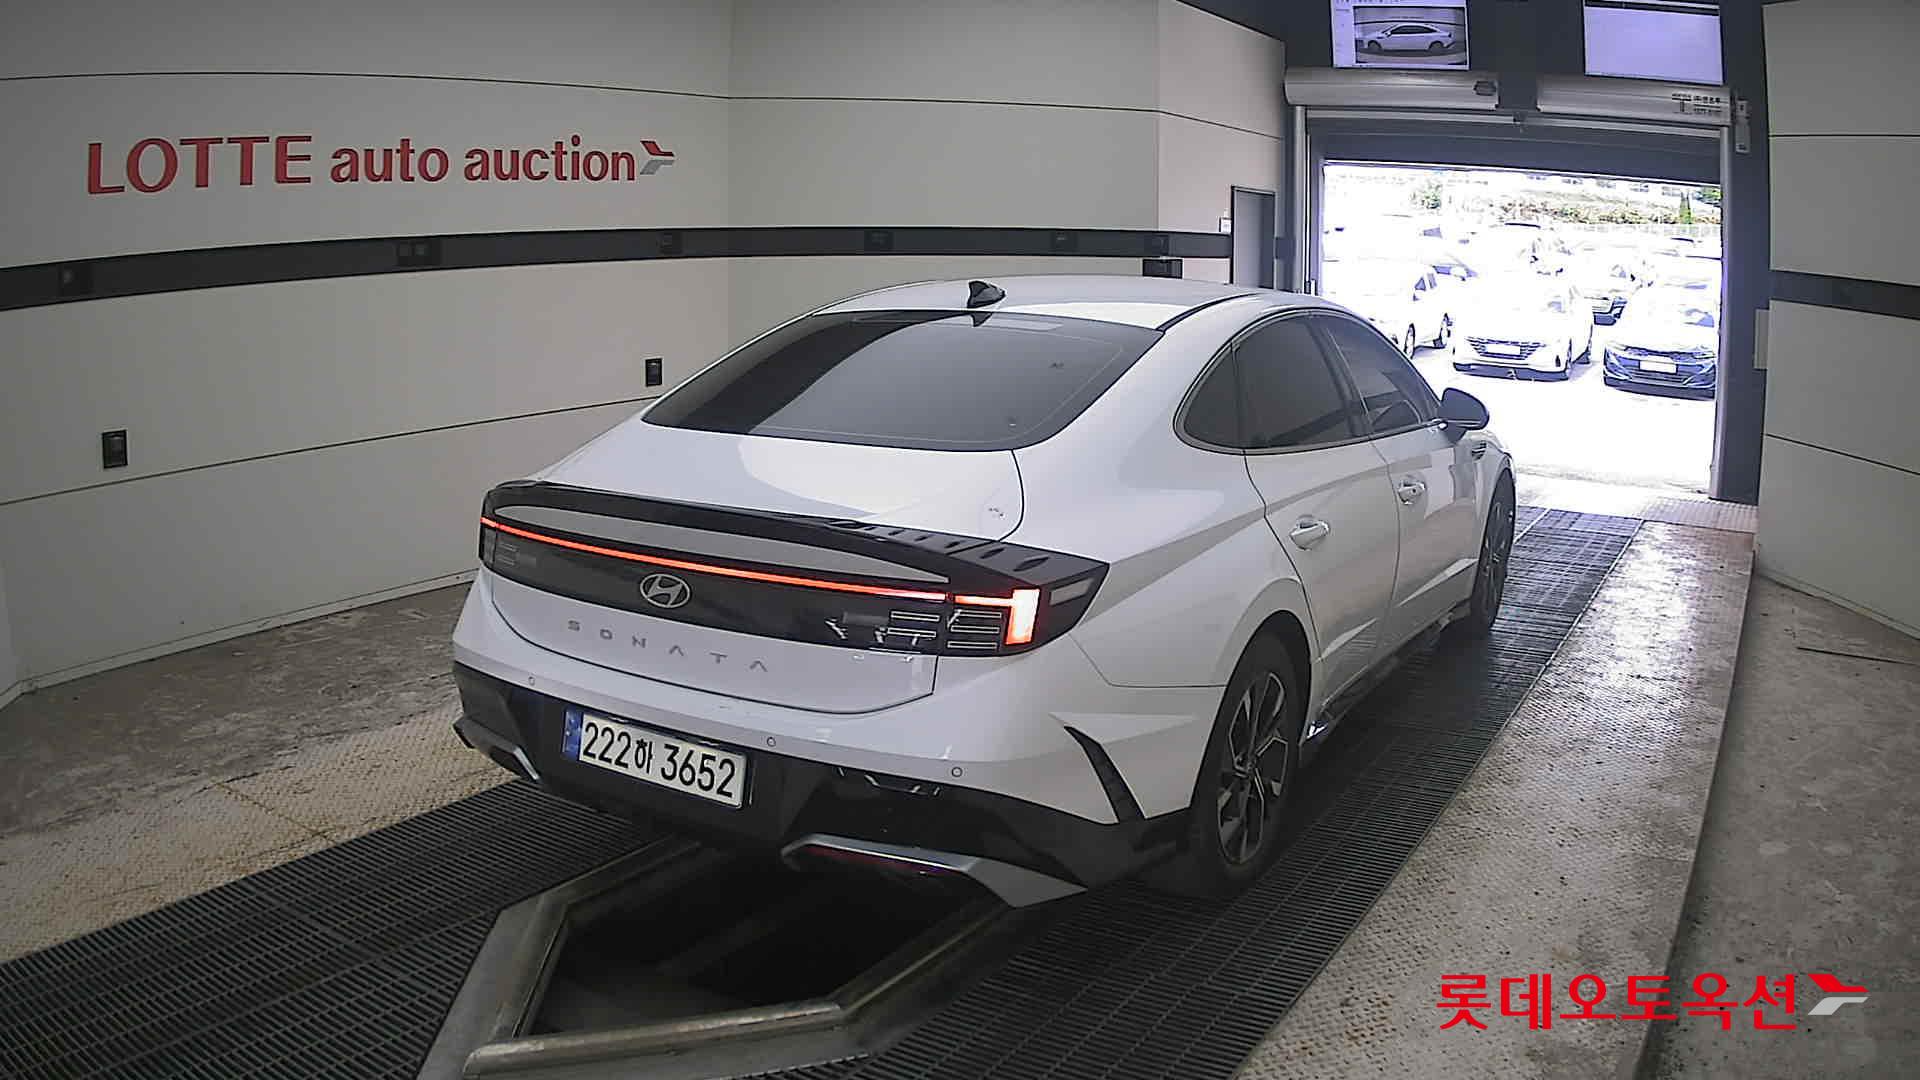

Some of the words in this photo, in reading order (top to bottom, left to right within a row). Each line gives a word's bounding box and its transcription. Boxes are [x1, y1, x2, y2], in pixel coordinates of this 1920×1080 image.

[87, 135, 312, 195] LOTTE
[330, 137, 449, 183] auto
[463, 134, 637, 182] auction
[567, 619, 768, 673] SONATA
[582, 721, 654, 775] 222하
[660, 742, 737, 799] 3652
